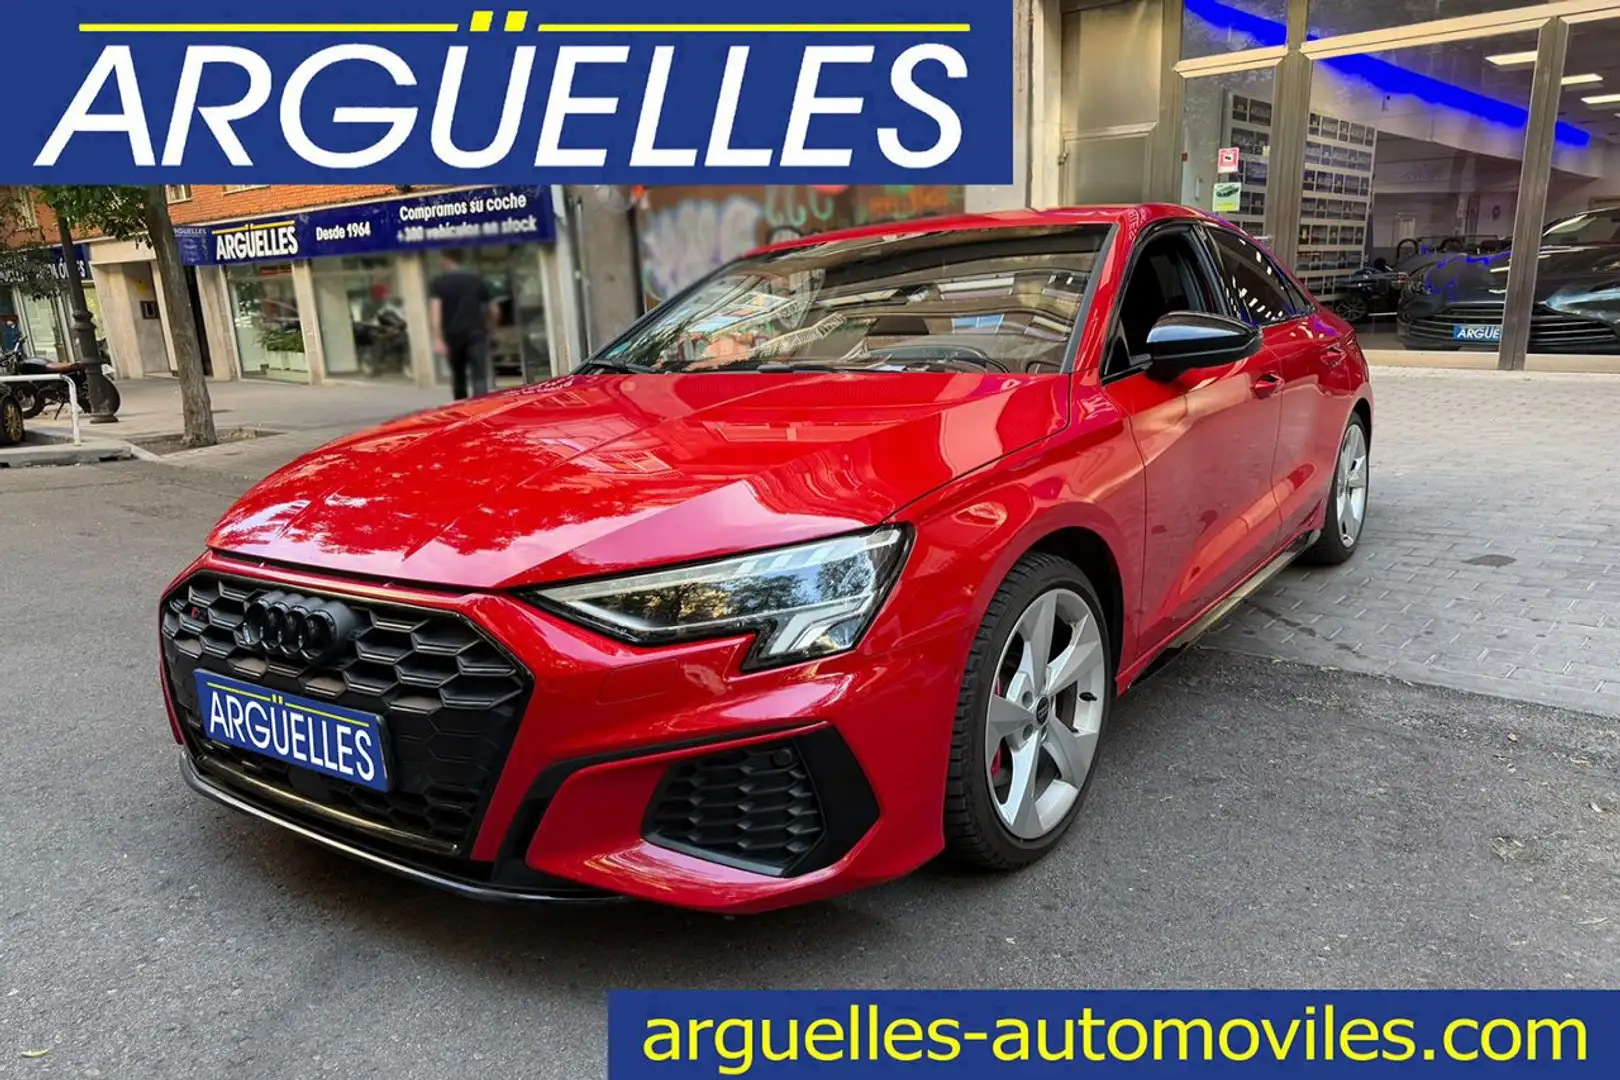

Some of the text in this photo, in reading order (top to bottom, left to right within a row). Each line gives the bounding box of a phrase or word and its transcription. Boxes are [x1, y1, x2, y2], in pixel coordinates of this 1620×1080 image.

[399, 193, 527, 221] Compramos su coche
[316, 221, 371, 241] Desde 1964
[501, 215, 538, 233] stock
[216, 223, 299, 260] ARGÜELLES
[209, 691, 375, 782] ARGÜELLES
